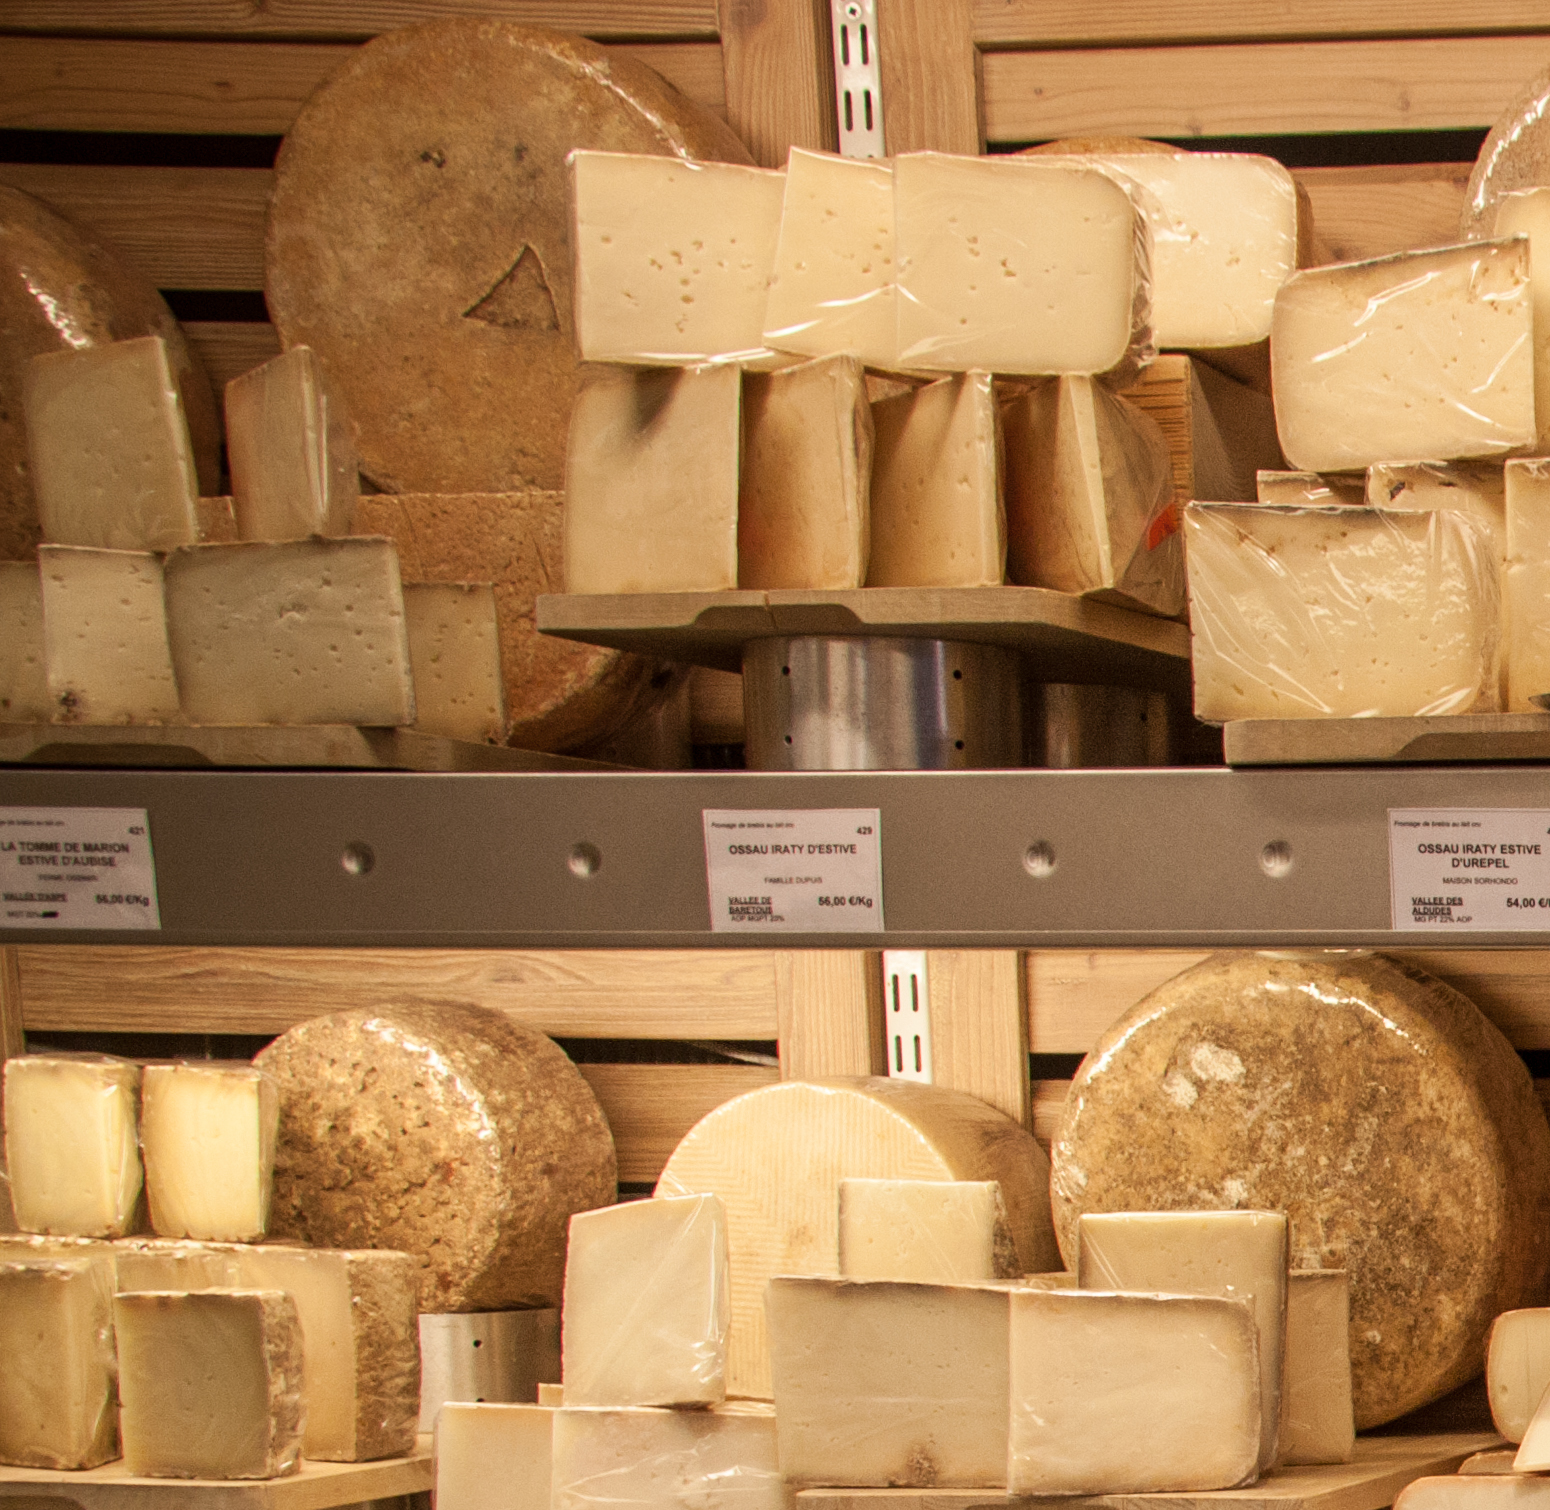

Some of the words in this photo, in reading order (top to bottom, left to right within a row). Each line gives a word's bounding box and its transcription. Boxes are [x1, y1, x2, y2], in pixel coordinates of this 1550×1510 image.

[729, 845, 768, 854] OSSAU
[772, 845, 803, 854] IRATY
[808, 845, 857, 854] D'ESTIVE
[1418, 844, 1459, 854] OSSAU
[1463, 845, 1496, 854] IRATY
[1500, 845, 1541, 854] ESTIVE
[1452, 858, 1509, 868] D'UREPEL
[1507, 898, 1535, 908] 54,00
